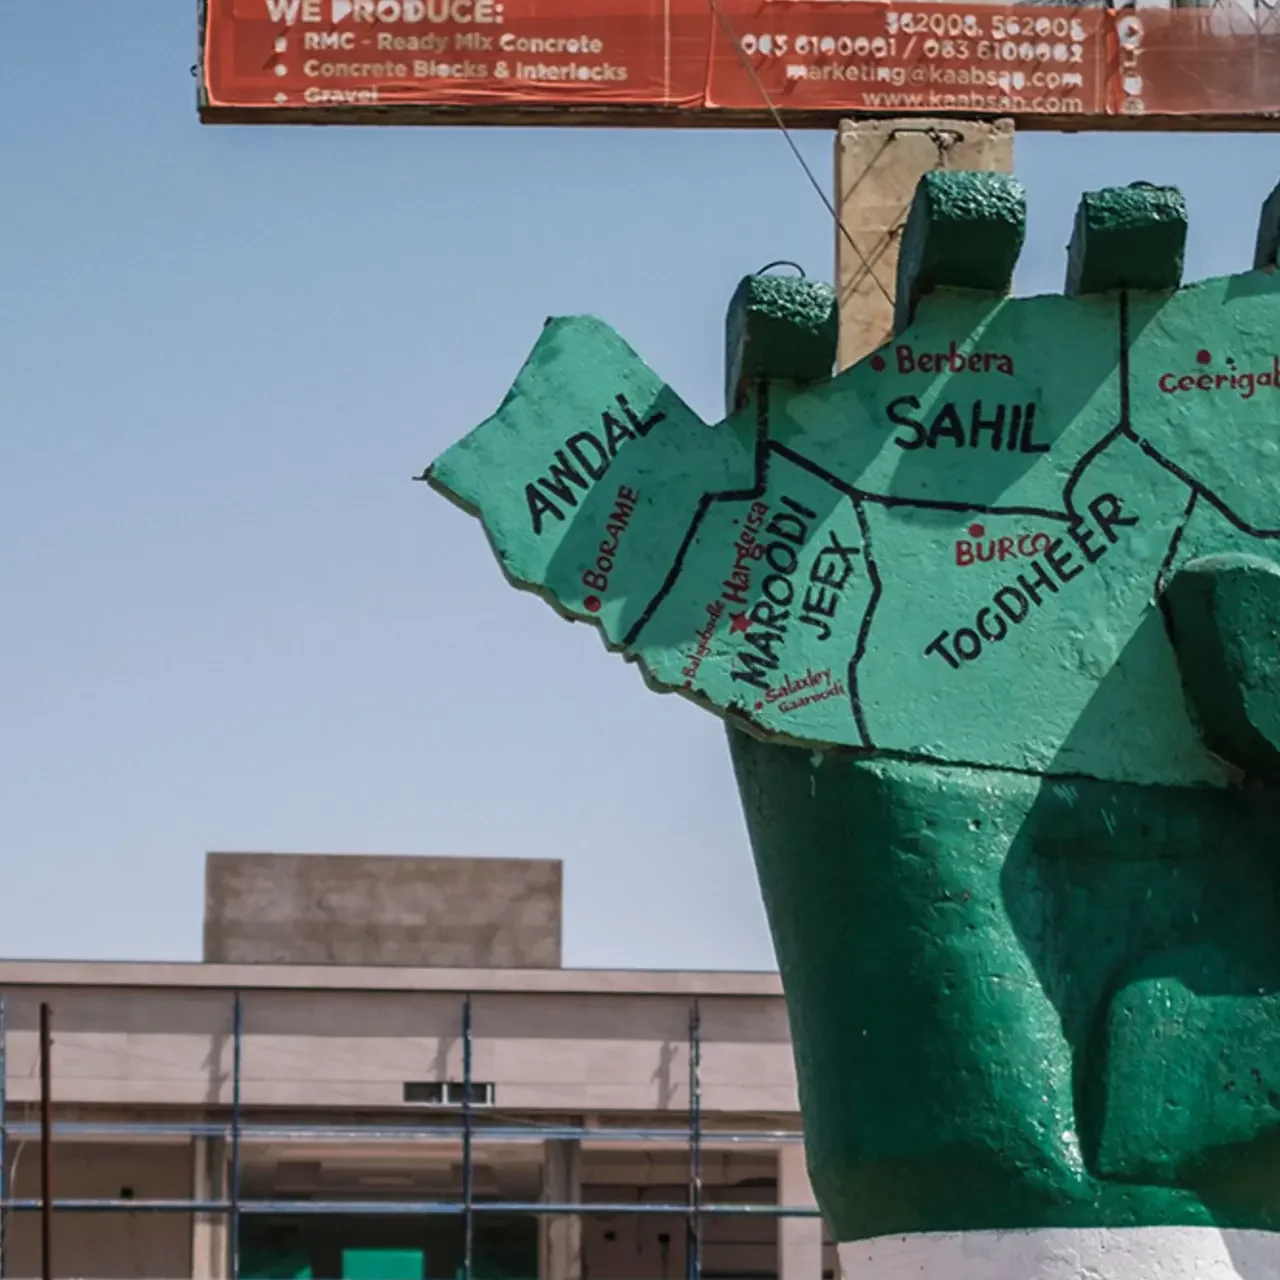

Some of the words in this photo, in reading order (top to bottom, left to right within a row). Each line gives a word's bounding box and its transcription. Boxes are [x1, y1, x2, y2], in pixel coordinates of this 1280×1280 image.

[266, 0, 322, 25] WE
[331, 0, 504, 25] PRODUCE:
[304, 32, 356, 50] RMC
[378, 32, 449, 54] Ready
[455, 32, 493, 50] Mix
[499, 33, 604, 53] Concrete
[903, 36, 917, 60] /
[304, 59, 407, 77] Concrete
[414, 60, 488, 78] Blocks
[493, 60, 509, 79] &
[516, 61, 628, 81] Interlocks
[786, 62, 1084, 91] marketing@kaabsan.com
[304, 85, 380, 103] Gravel
[862, 89, 1083, 113] www.kaabsan.com
[895, 340, 1014, 376] Berbera
[885, 395, 1051, 453] SAHIL
[525, 393, 666, 535] AWDAL
[582, 485, 640, 592] BORAME
[722, 501, 769, 604] Hargeisa
[955, 532, 1051, 567] BURCO
[730, 496, 817, 688] MAROODI
[799, 530, 861, 641] JEEX
